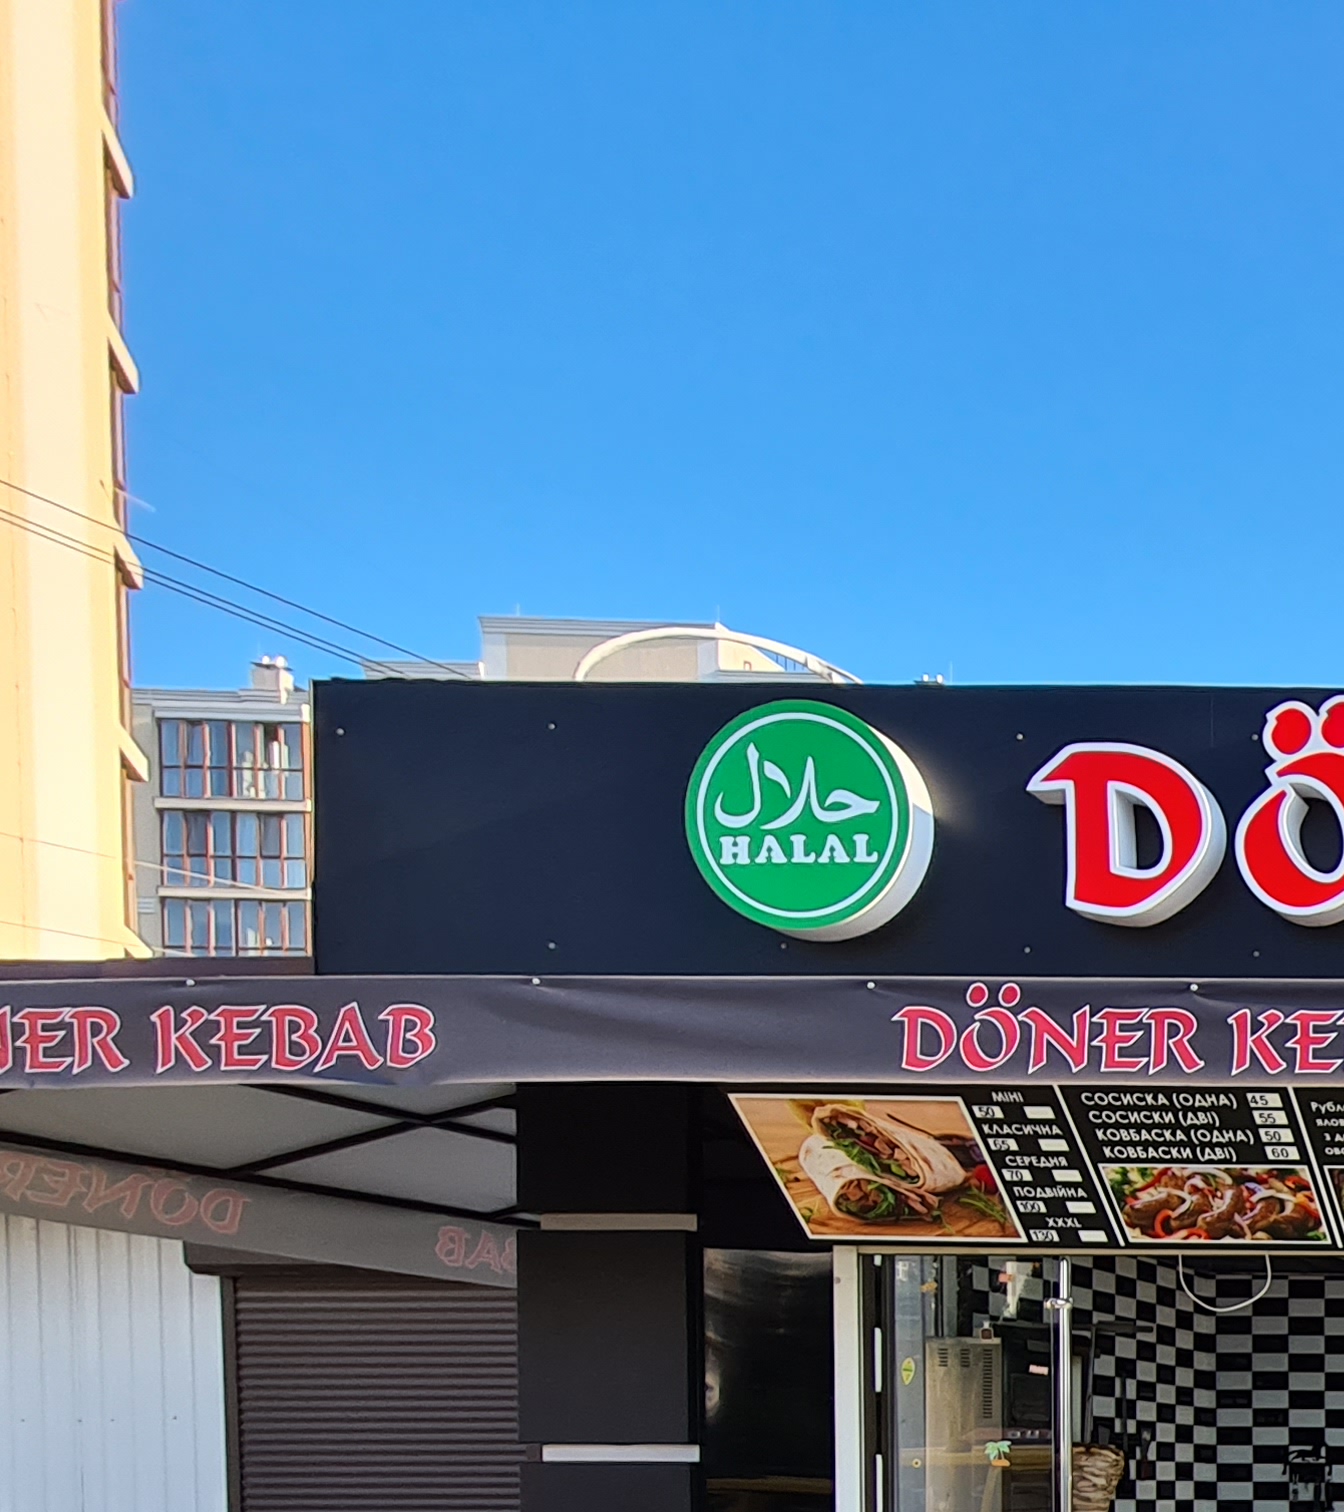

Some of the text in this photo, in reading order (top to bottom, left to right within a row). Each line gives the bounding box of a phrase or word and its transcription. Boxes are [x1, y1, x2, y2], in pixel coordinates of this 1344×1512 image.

[714, 742, 881, 830] حلال
[719, 833, 879, 866] HALAL
[891, 982, 1205, 1075] DÖNER
[150, 1001, 437, 1075] KEBAB
[991, 1091, 1024, 1103] МІНІ
[1080, 1091, 1269, 1110] СОСИСКА (ОДНА) 45
[978, 1106, 995, 1118] 50
[1088, 1110, 1276, 1127] СОСИСКИ (ДВІ) 55
[982, 1123, 1063, 1136] КЛАСИЧНА
[1095, 1128, 1281, 1145] КОВБАСКА (ОДНА) 50
[1005, 1155, 1069, 1168] СЕРЕДНЯ
[1102, 1145, 1289, 1162] КОВБАСКИ (ДВІ) 60
[1013, 1185, 1088, 1198] ПОДВІЙНА
[1045, 1216, 1082, 1228] XXXL
